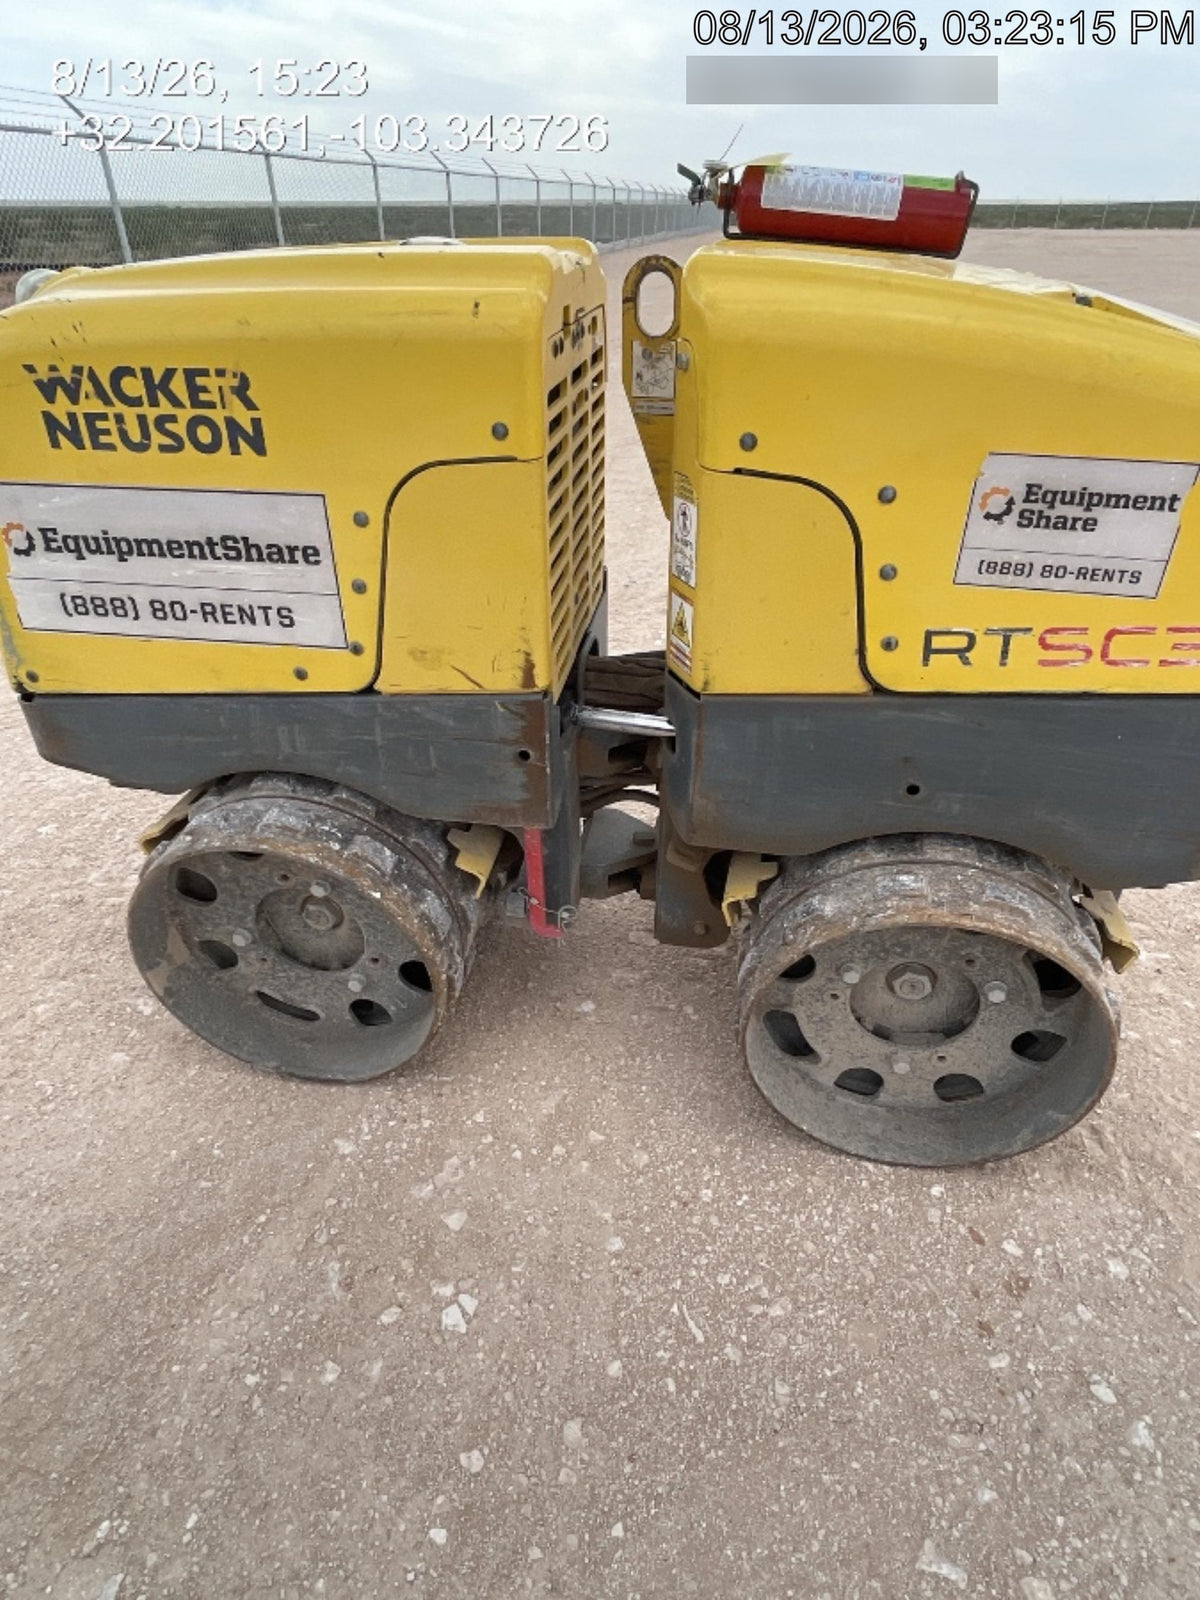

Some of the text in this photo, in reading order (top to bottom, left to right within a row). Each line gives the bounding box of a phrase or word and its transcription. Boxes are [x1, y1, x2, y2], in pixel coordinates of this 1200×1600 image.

[22, 364, 260, 411] WACKER
[41, 410, 268, 457] NEUSON
[1022, 483, 1181, 513] Equipment
[1016, 508, 1098, 532] Share
[37, 527, 322, 566] EquipmentShare
[977, 559, 1142, 584] (888) 80-RENTS
[59, 592, 296, 629] (888) 80-RENTS
